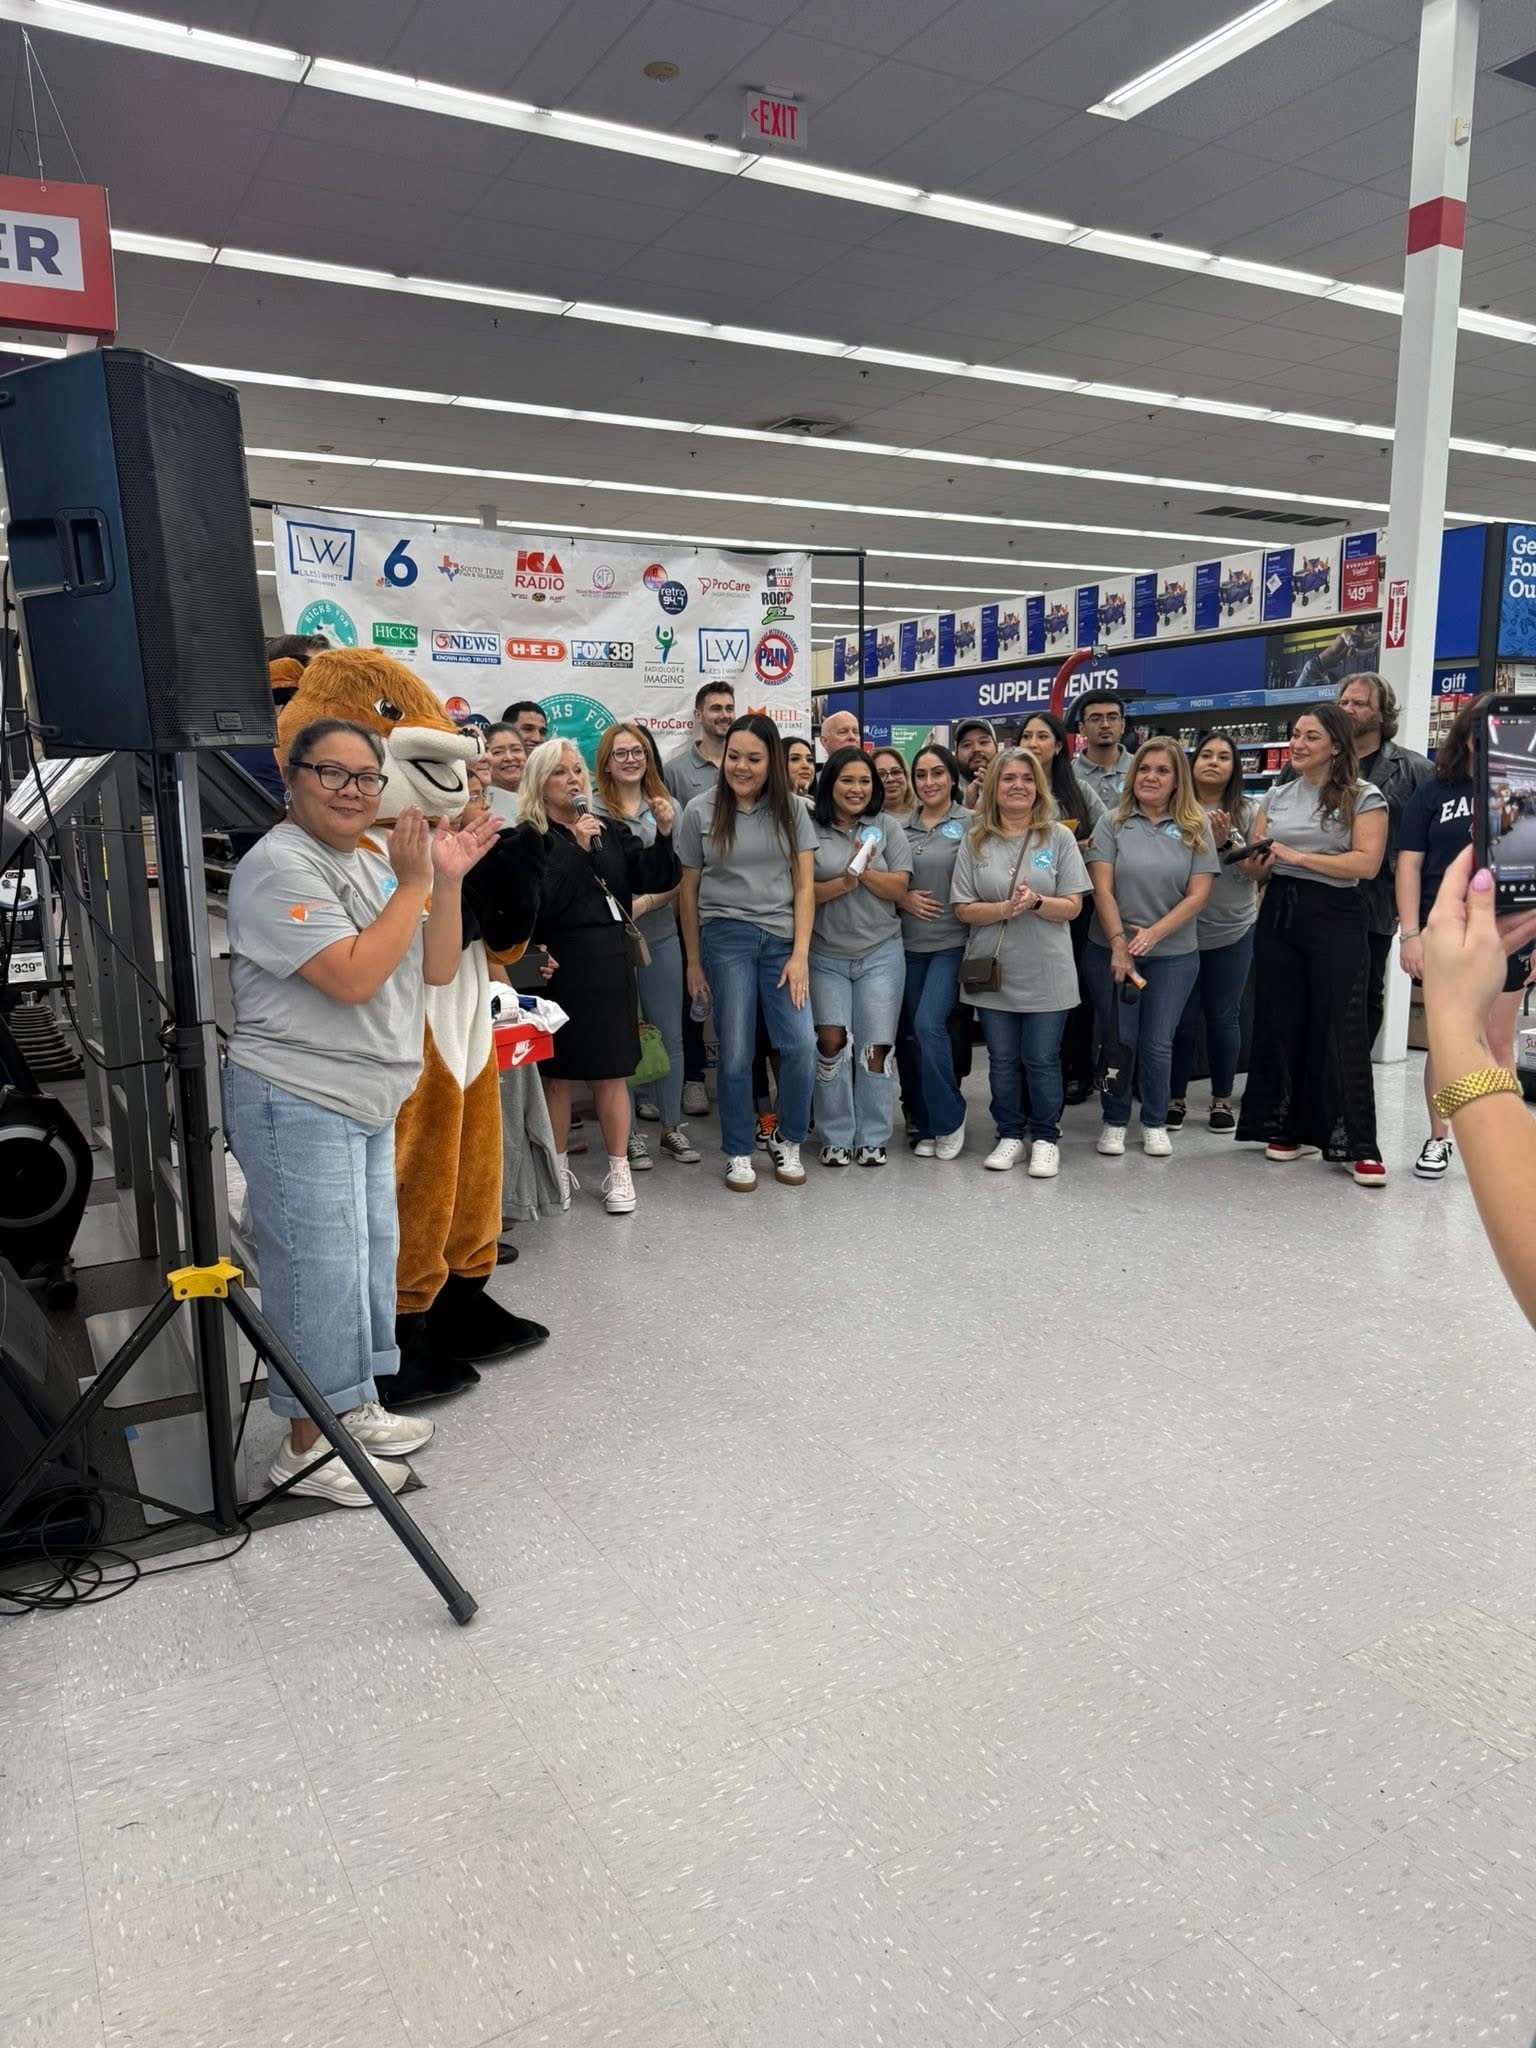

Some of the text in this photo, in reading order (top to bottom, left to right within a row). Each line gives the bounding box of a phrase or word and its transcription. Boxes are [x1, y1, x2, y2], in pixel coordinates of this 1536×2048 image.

[760, 99, 798, 140] EXIT
[0, 223, 63, 276] R
[296, 535, 347, 565] LW
[384, 539, 418, 587] 6
[485, 567, 504, 576] TEXAS
[515, 575, 564, 591] RADIO
[712, 578, 751, 592] ProCare
[661, 587, 686, 597] retro
[304, 604, 332, 624] HICKS
[375, 625, 416, 640] HICKS
[450, 635, 497, 651] NEWS
[705, 639, 744, 662] LW
[643, 674, 685, 685] IMAGING
[1441, 672, 1467, 694] gift
[650, 718, 694, 729] ProCare
